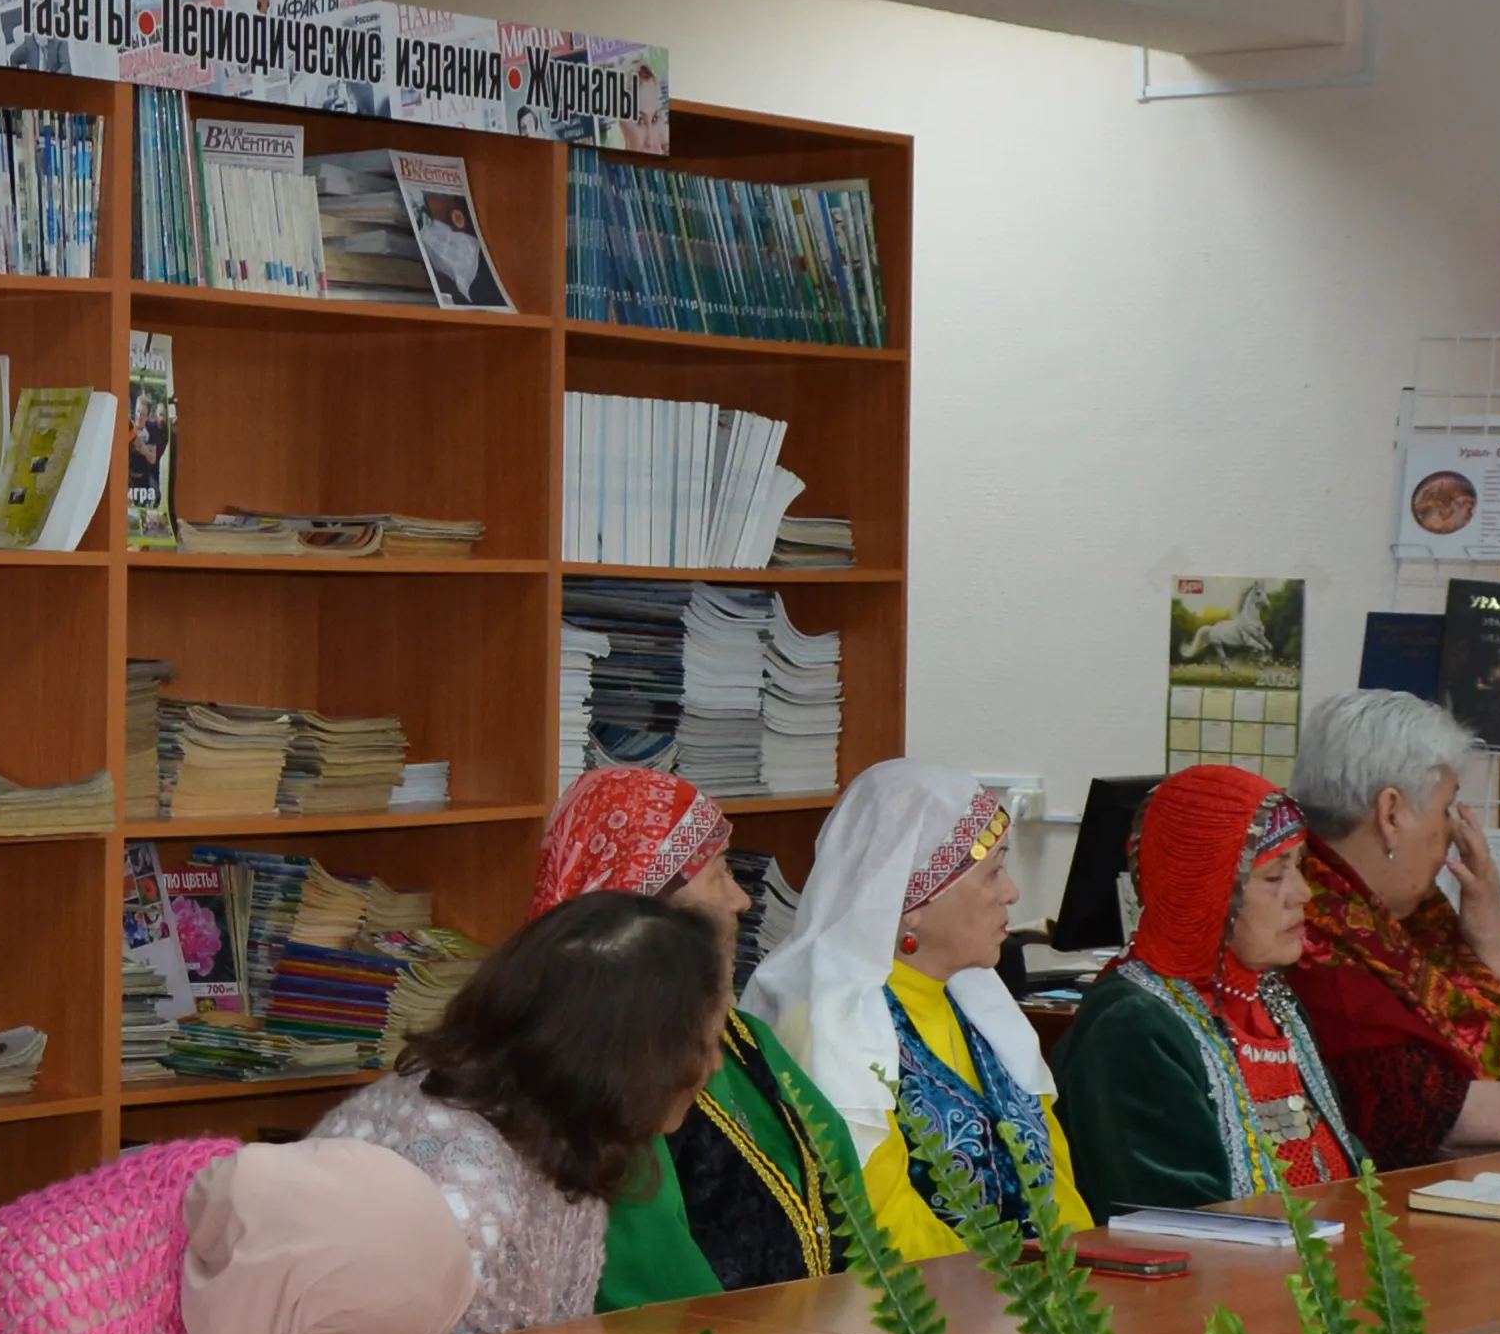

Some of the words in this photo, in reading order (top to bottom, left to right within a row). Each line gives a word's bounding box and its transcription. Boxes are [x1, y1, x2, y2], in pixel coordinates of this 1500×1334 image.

[396, 37, 501, 101] издания
[526, 46, 638, 122] Журналы
[206, 984, 225, 994] 700
